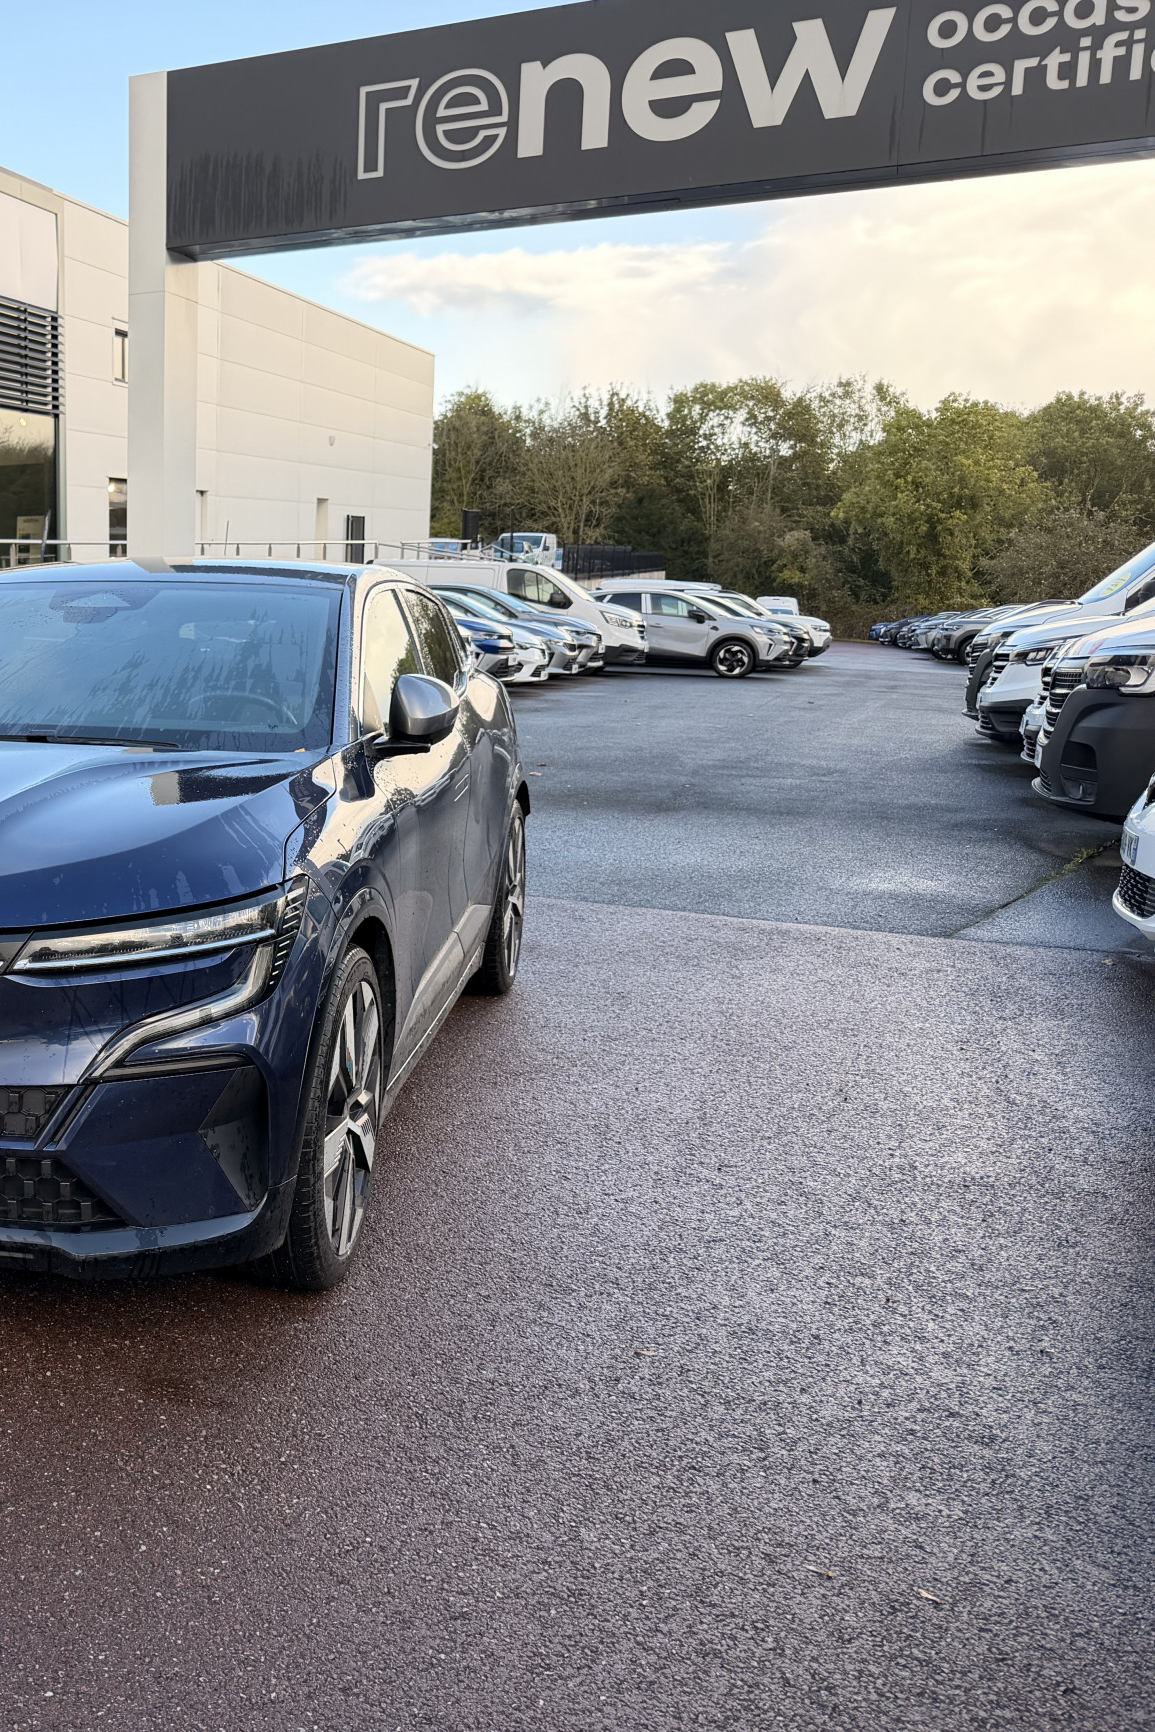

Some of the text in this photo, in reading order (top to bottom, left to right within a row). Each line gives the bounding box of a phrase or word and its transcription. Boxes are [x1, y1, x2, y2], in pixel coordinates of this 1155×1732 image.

[927, 0, 1151, 49] occas
[357, 6, 898, 180] renew
[922, 27, 1155, 106] certifi
